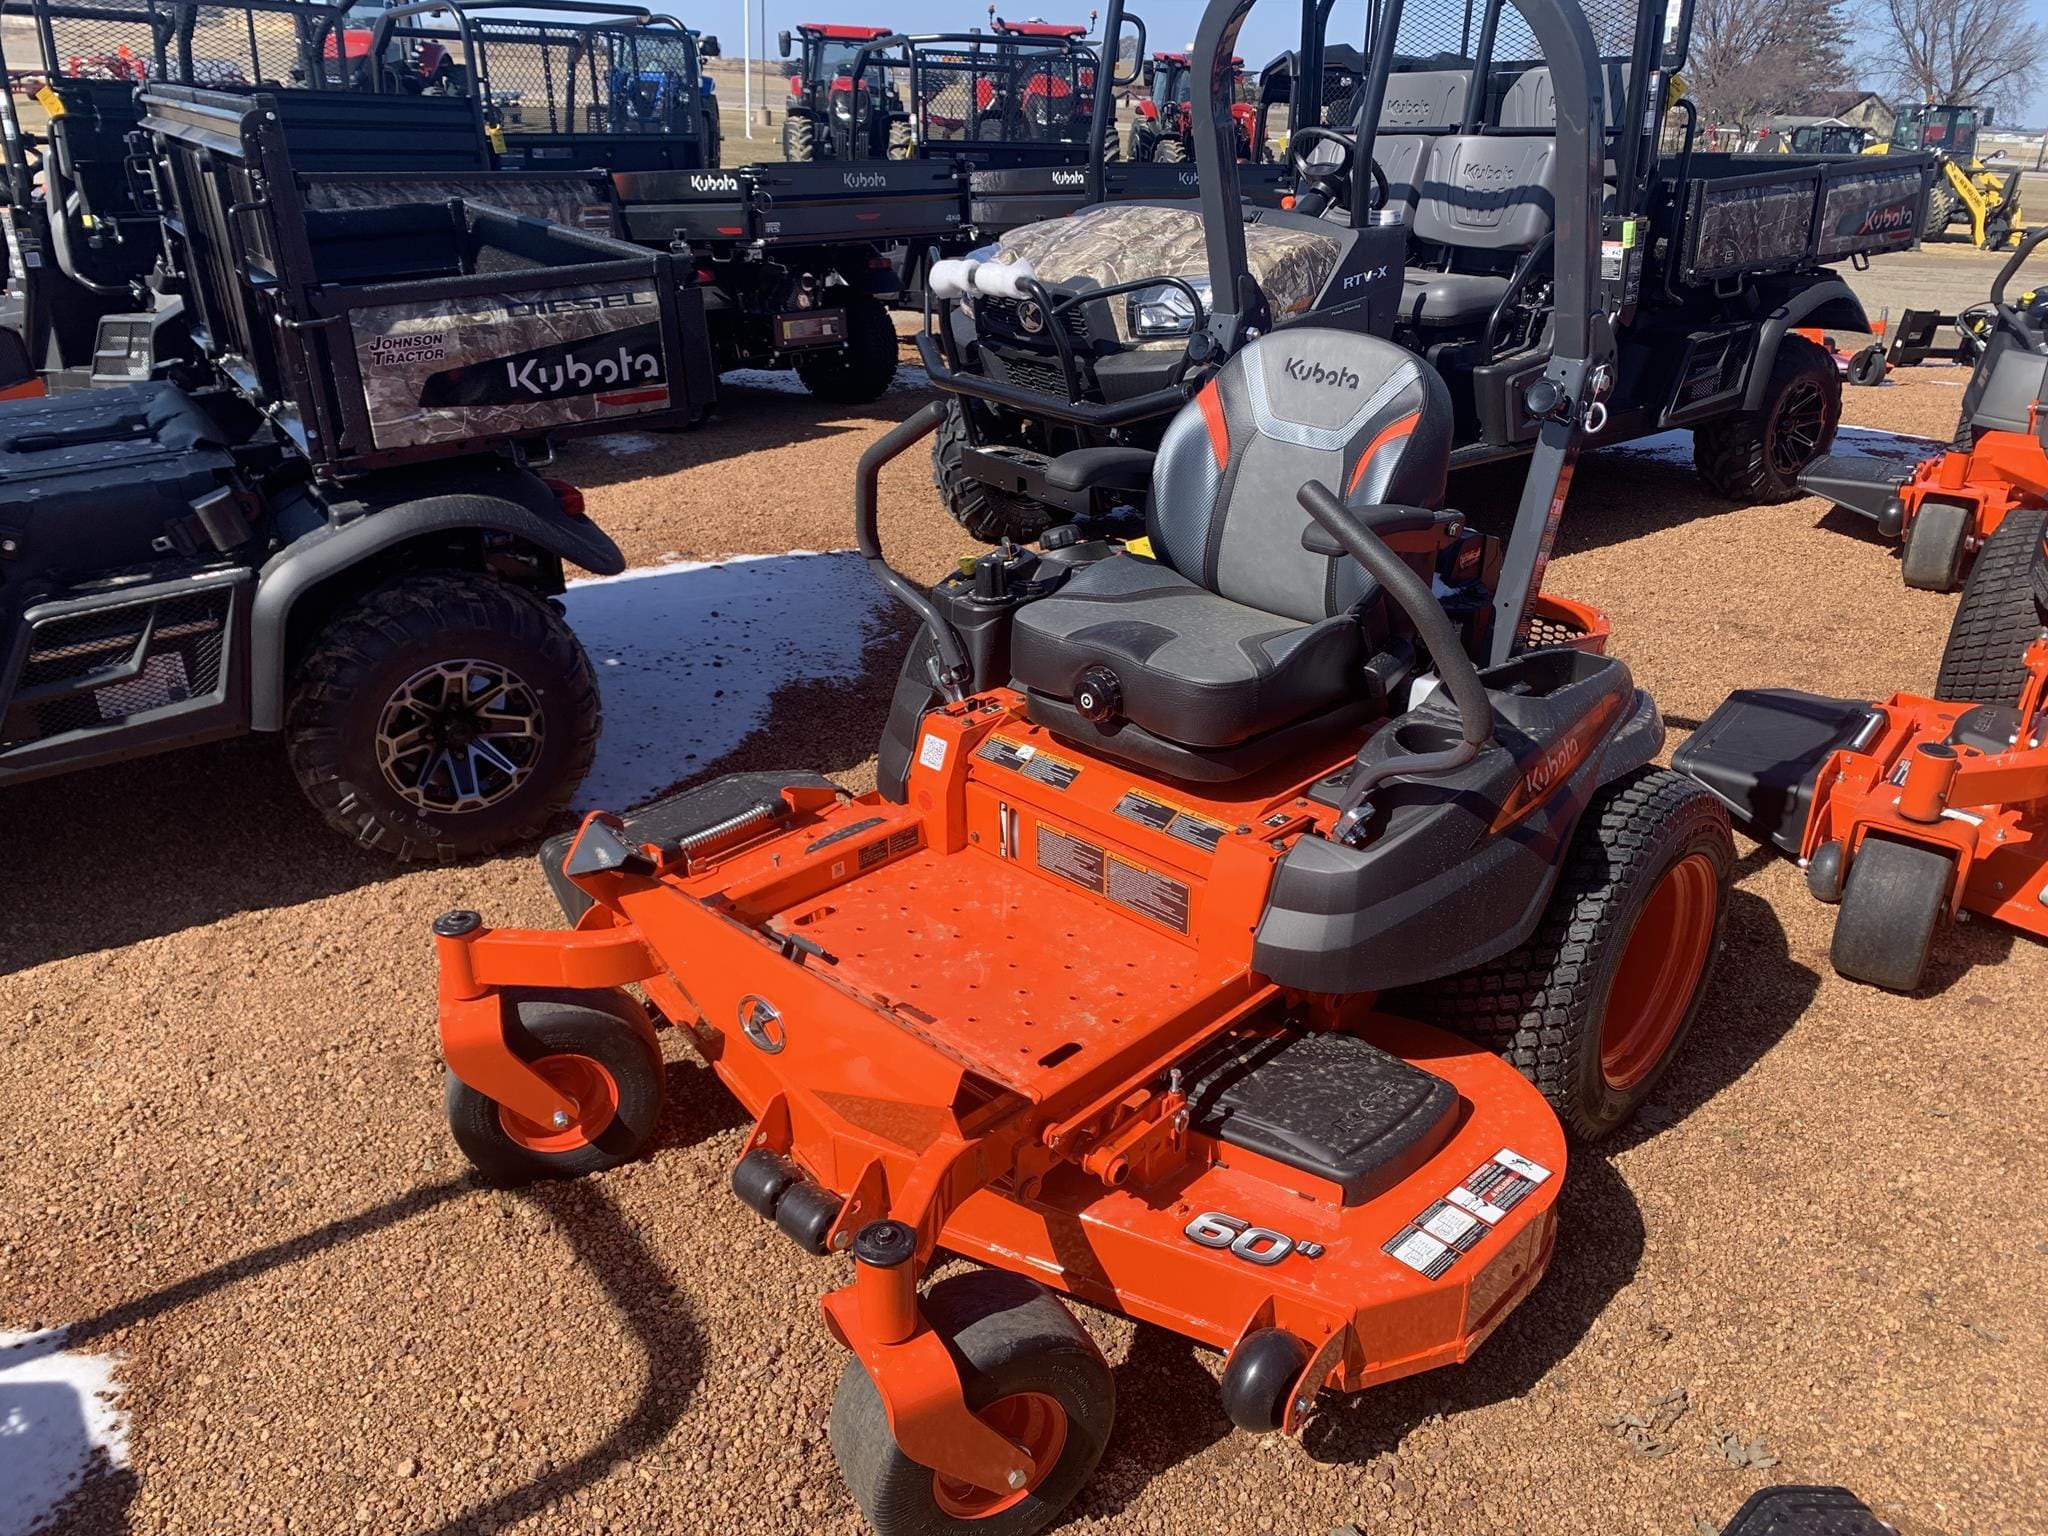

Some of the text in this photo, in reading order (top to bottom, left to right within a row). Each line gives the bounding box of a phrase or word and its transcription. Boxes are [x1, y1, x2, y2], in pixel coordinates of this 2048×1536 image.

[843, 172, 887, 188] Kubota
[1052, 171, 1085, 185] Kubota
[1178, 171, 1201, 186] Kub
[1463, 163, 1514, 182] Kubota
[690, 174, 739, 192] Kubota
[1864, 204, 1913, 231] Kubota
[1343, 265, 1389, 290] RTV-X
[508, 291, 658, 317] DIESEL
[369, 334, 443, 351] JOHNSON
[372, 348, 444, 366] TRACTOR
[507, 346, 659, 394] Kubota
[1284, 356, 1360, 390] Kubota
[1525, 737, 1579, 792] Kubota
